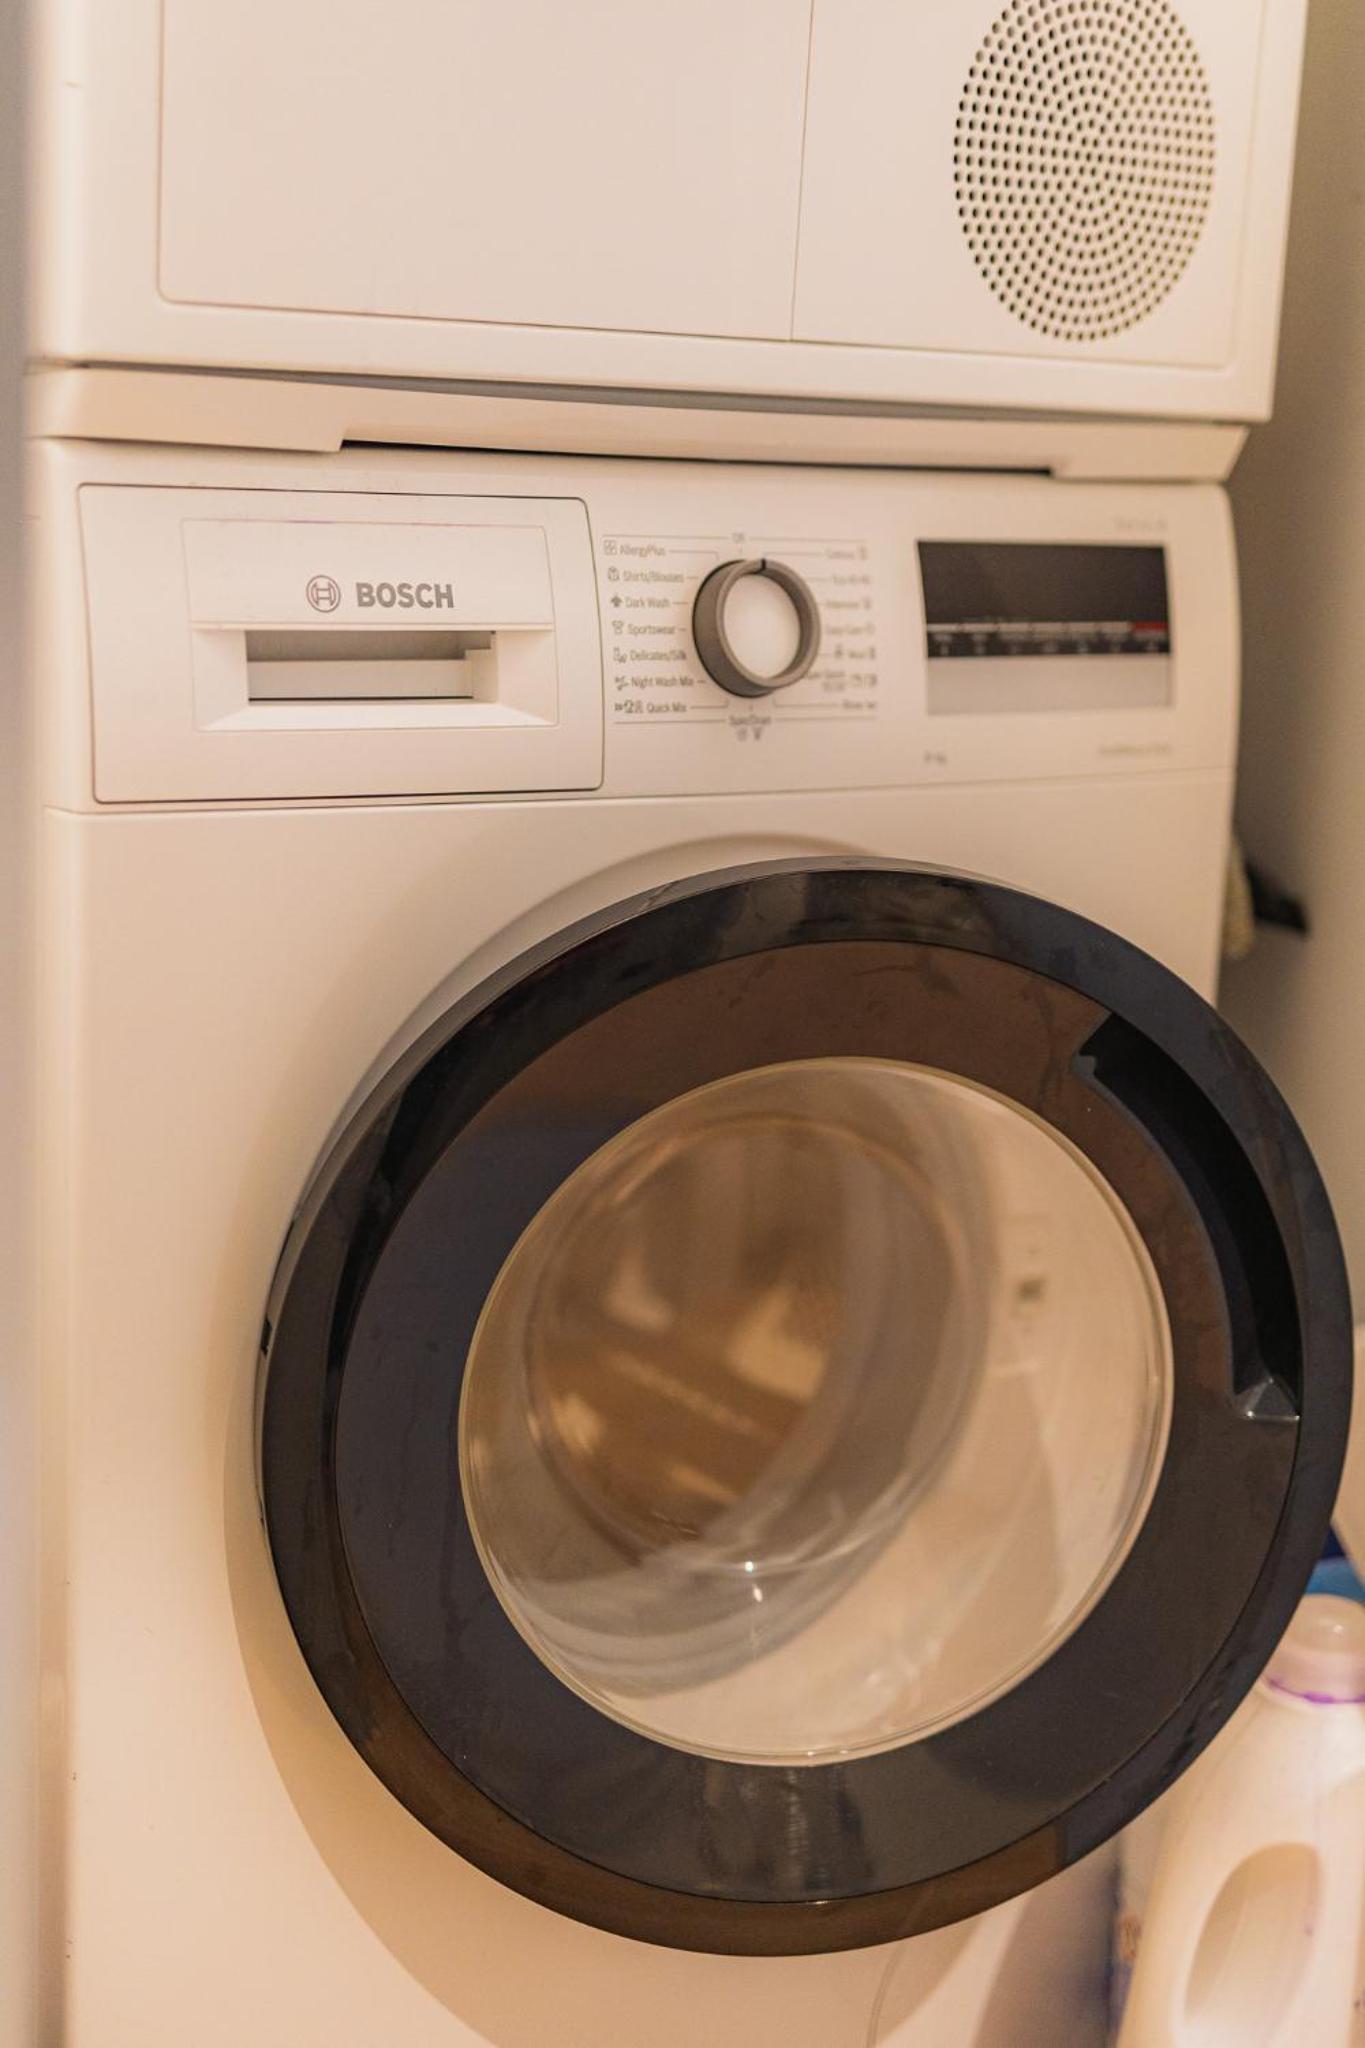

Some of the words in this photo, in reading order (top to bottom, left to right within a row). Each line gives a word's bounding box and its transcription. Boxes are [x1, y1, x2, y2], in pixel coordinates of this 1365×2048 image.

[355, 582, 454, 609] BOSCH
[625, 597, 645, 608] Dark
[647, 597, 671, 608] Wash
[628, 623, 675, 637] Sportswear
[631, 676, 653, 690] Night
[655, 676, 677, 687] Wash
[679, 676, 694, 686] Mix
[646, 702, 670, 713] Quick
[671, 702, 687, 712] Mix
